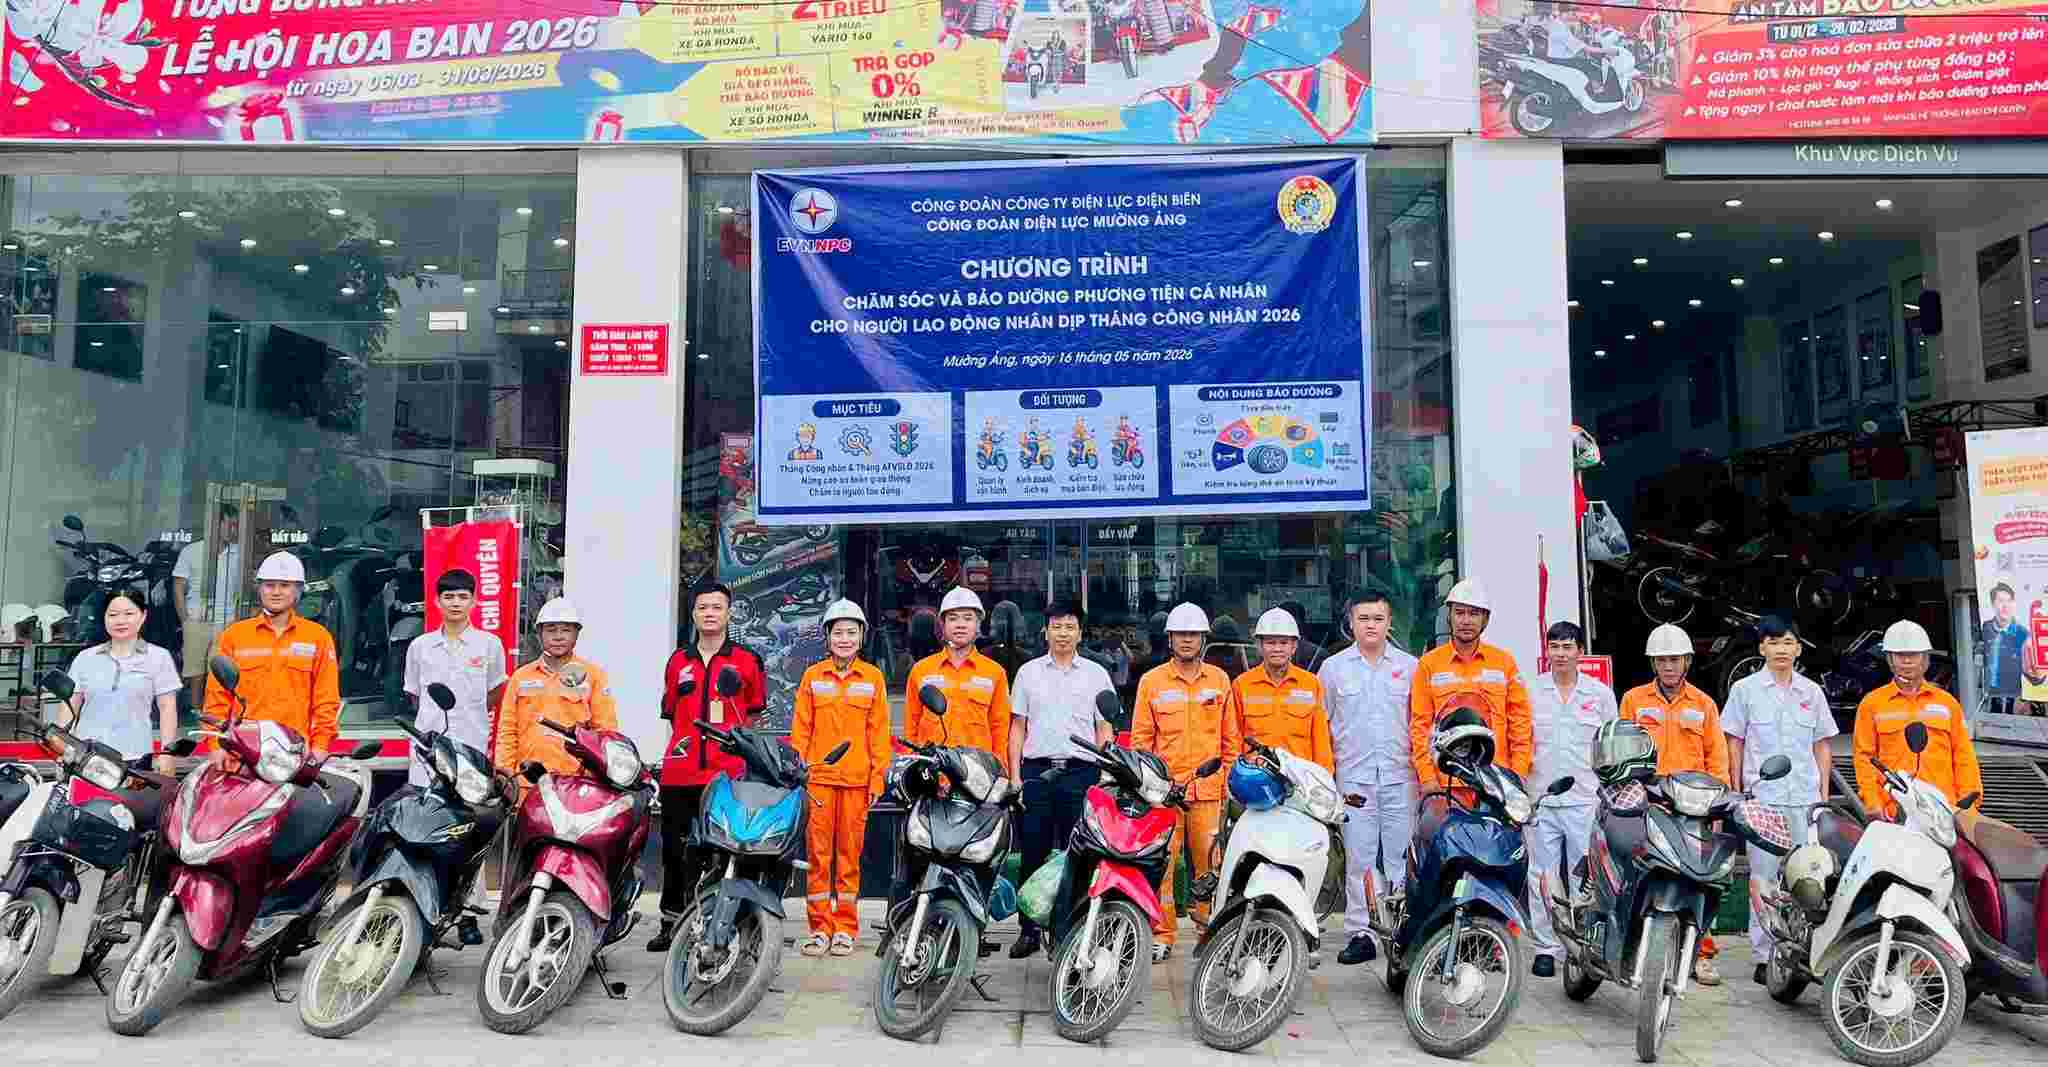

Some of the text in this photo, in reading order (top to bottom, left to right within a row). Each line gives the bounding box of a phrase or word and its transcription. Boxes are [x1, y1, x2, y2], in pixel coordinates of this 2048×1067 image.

[811, 31, 872, 43] VARIO 160
[816, 21, 862, 31] KHI MUA
[160, 16, 601, 78] LỄ HỘI HOA BAN 2026
[679, 40, 694, 49] XE
[714, 36, 755, 47] HONDA
[1712, 49, 1753, 64] Giảm
[1780, 45, 1809, 60] cho
[1945, 33, 1956, 47] 2
[1959, 31, 1993, 46] triệu
[853, 48, 936, 72] TRẢ GÓP
[1708, 69, 1748, 85] Giảm
[1752, 67, 1779, 81] 10%
[1784, 65, 1805, 79] khi
[1808, 62, 1841, 78] thay
[871, 72, 921, 98] 0%
[729, 117, 745, 127] XE
[767, 112, 809, 124] HONDA
[863, 108, 922, 123] WINNER
[1731, 102, 1765, 118] ngay
[1775, 99, 1805, 112] chai
[1795, 144, 1959, 167] Khu Vực Dịch Vụ
[911, 192, 1201, 214] CÔNG ĐOÀN CÔNG TY ĐIỆN LỰC ĐIỆN BIÊN
[926, 208, 1187, 233] CÔNG ĐOÀN ĐIỆN LỰC MƯỜNG ẢNG
[960, 251, 1149, 281] CHƯƠNG TRÌNH
[842, 280, 1267, 311] CHĂM SÓC VÀ BẢO DƯỠNG PHƯƠNG TIỆN CÁ NHÂN
[809, 305, 1301, 337] CHO NGƯỜI LAO ĐỘNG NHÂN DỊP THÁNG CÔNG NHÂN 2026
[942, 353, 986, 370] Mường
[1022, 350, 1055, 368] ngày
[1058, 351, 1074, 363] 16
[1076, 349, 1112, 366] tháng
[1113, 350, 1130, 362] 05
[1132, 349, 1161, 362] năm
[1163, 348, 1193, 361] 2026
[1033, 391, 1087, 407] ĐỐI TƯỢNG
[1208, 384, 1333, 400] NỘI DUNG BẢO DƯỠNG
[832, 402, 881, 416] MỤC TIÊU
